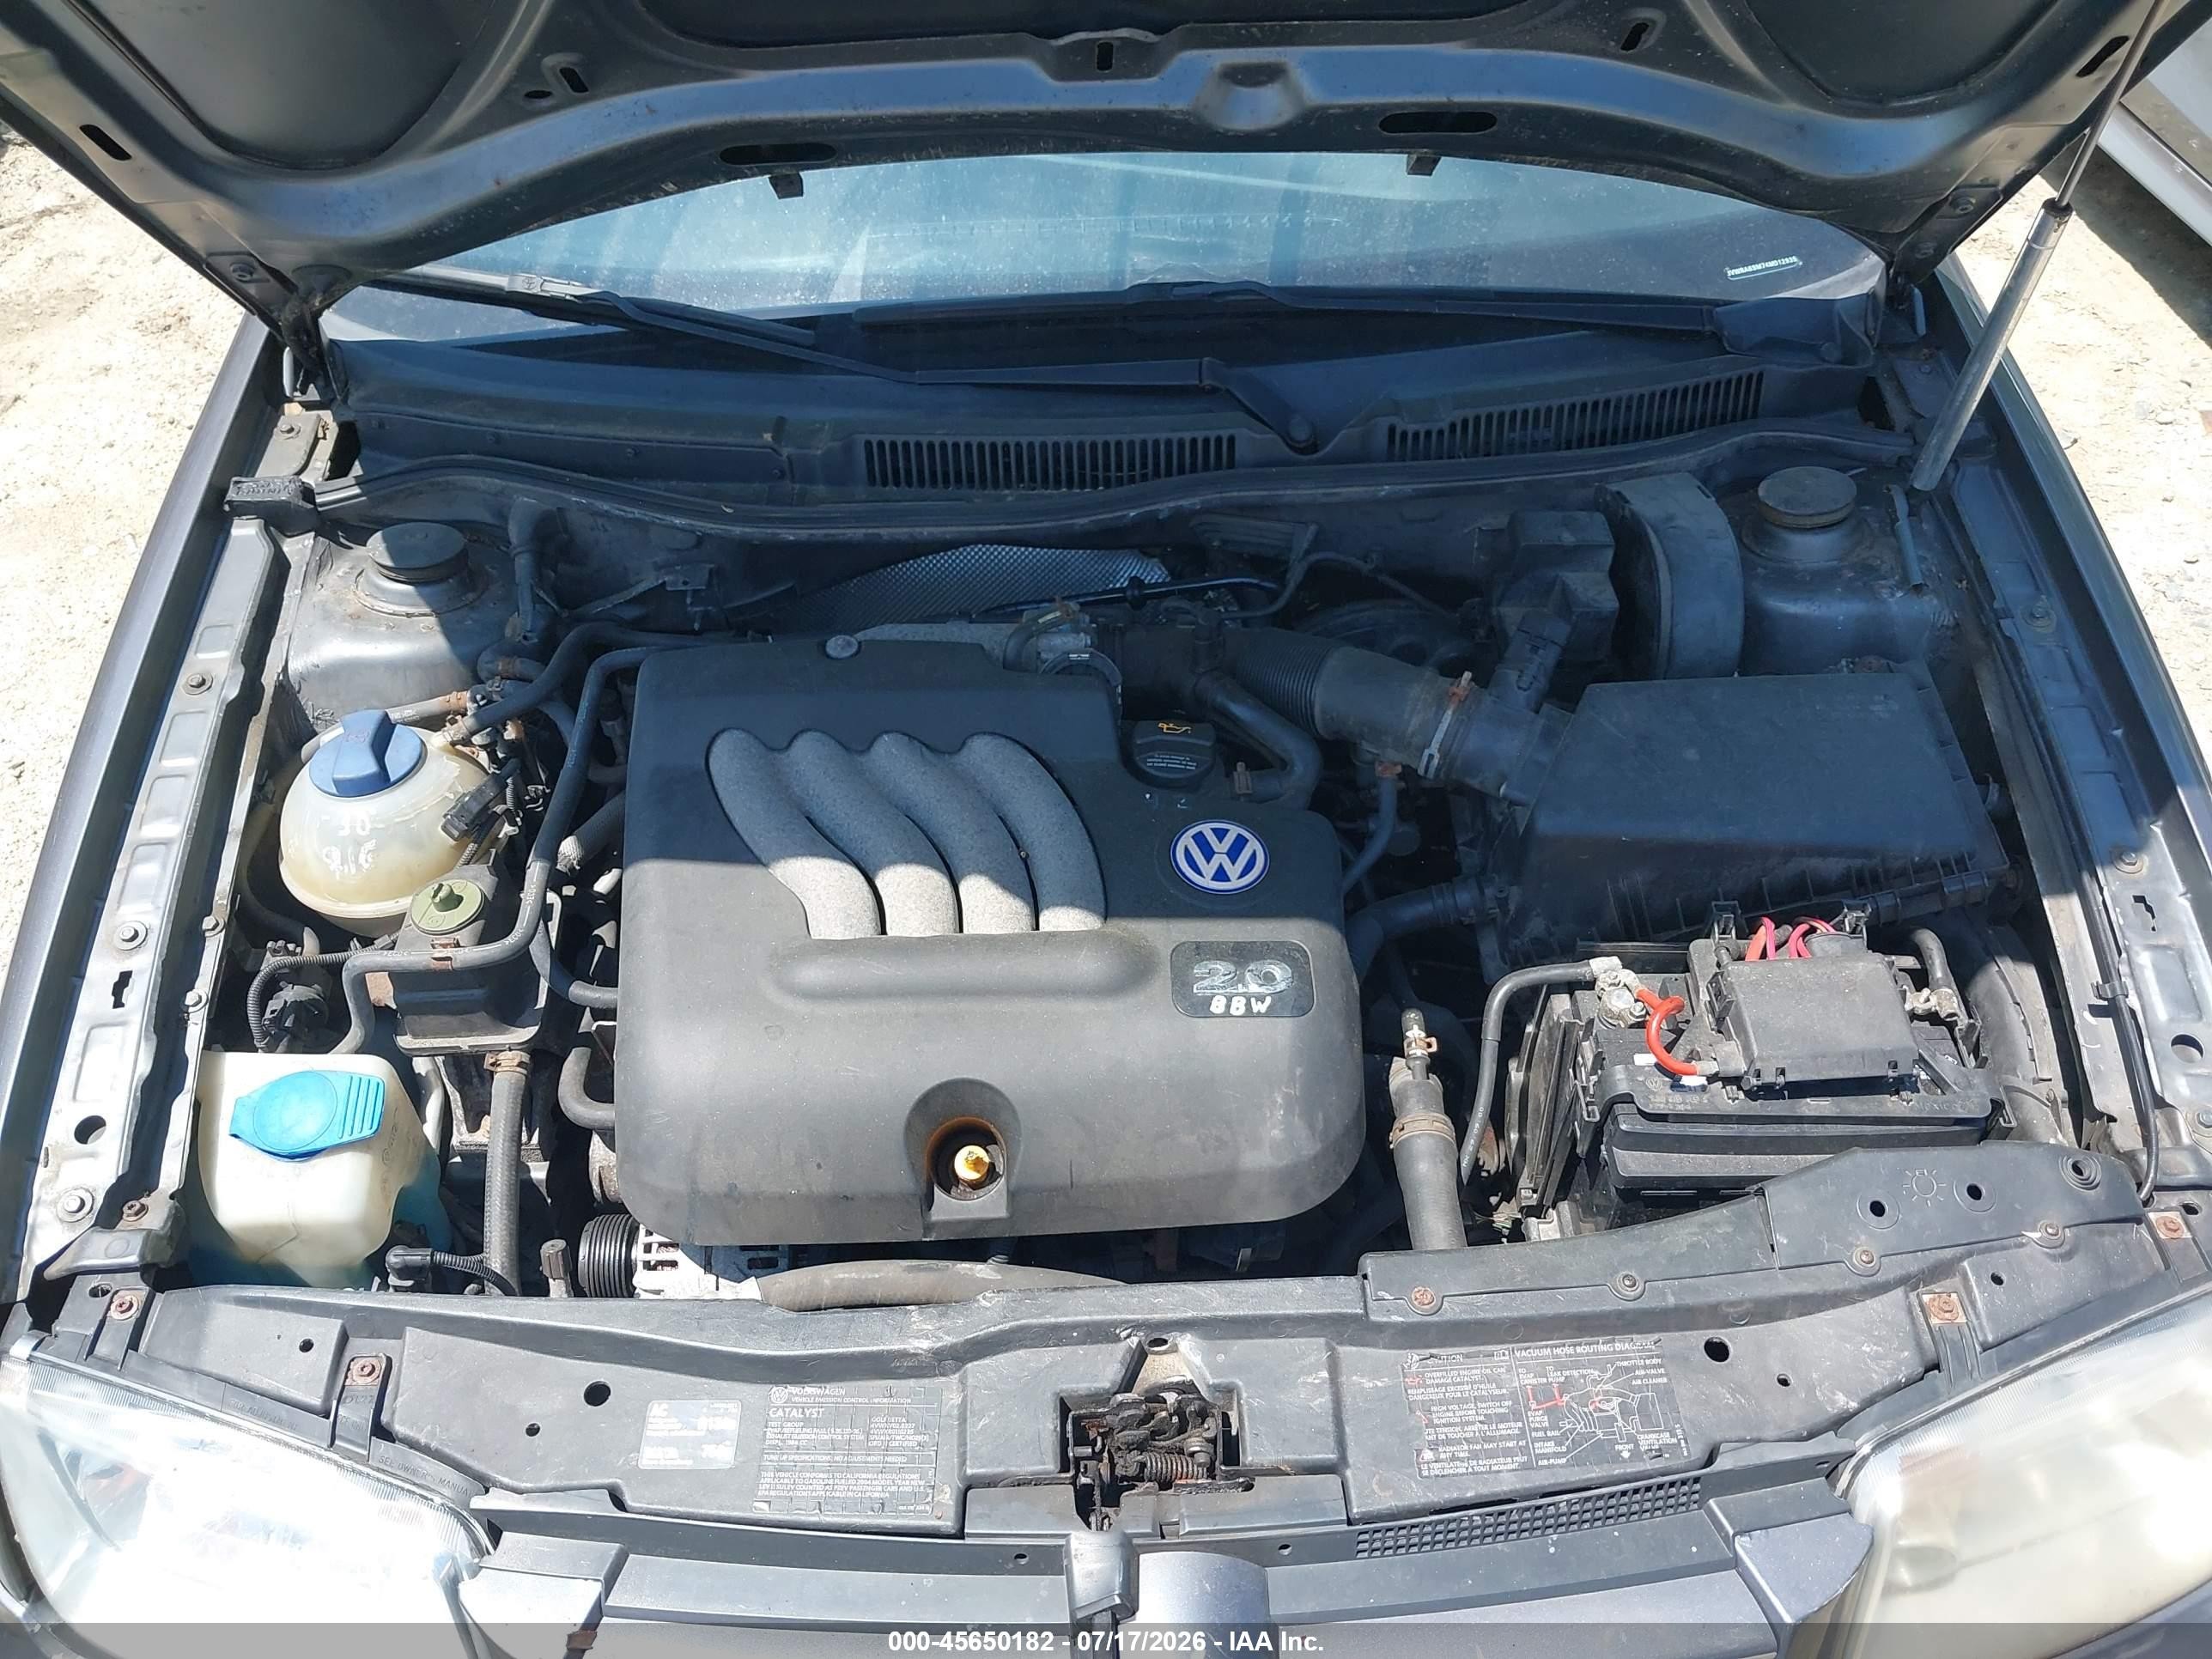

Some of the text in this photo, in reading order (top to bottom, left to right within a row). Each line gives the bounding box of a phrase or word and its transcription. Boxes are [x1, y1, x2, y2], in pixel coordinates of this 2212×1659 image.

[1516, 1349, 1551, 1358] VACUUM
[1553, 1346, 1574, 1355] HOSE
[1576, 1345, 1613, 1354] ROUTING
[769, 1408, 824, 1418] CATALYST
